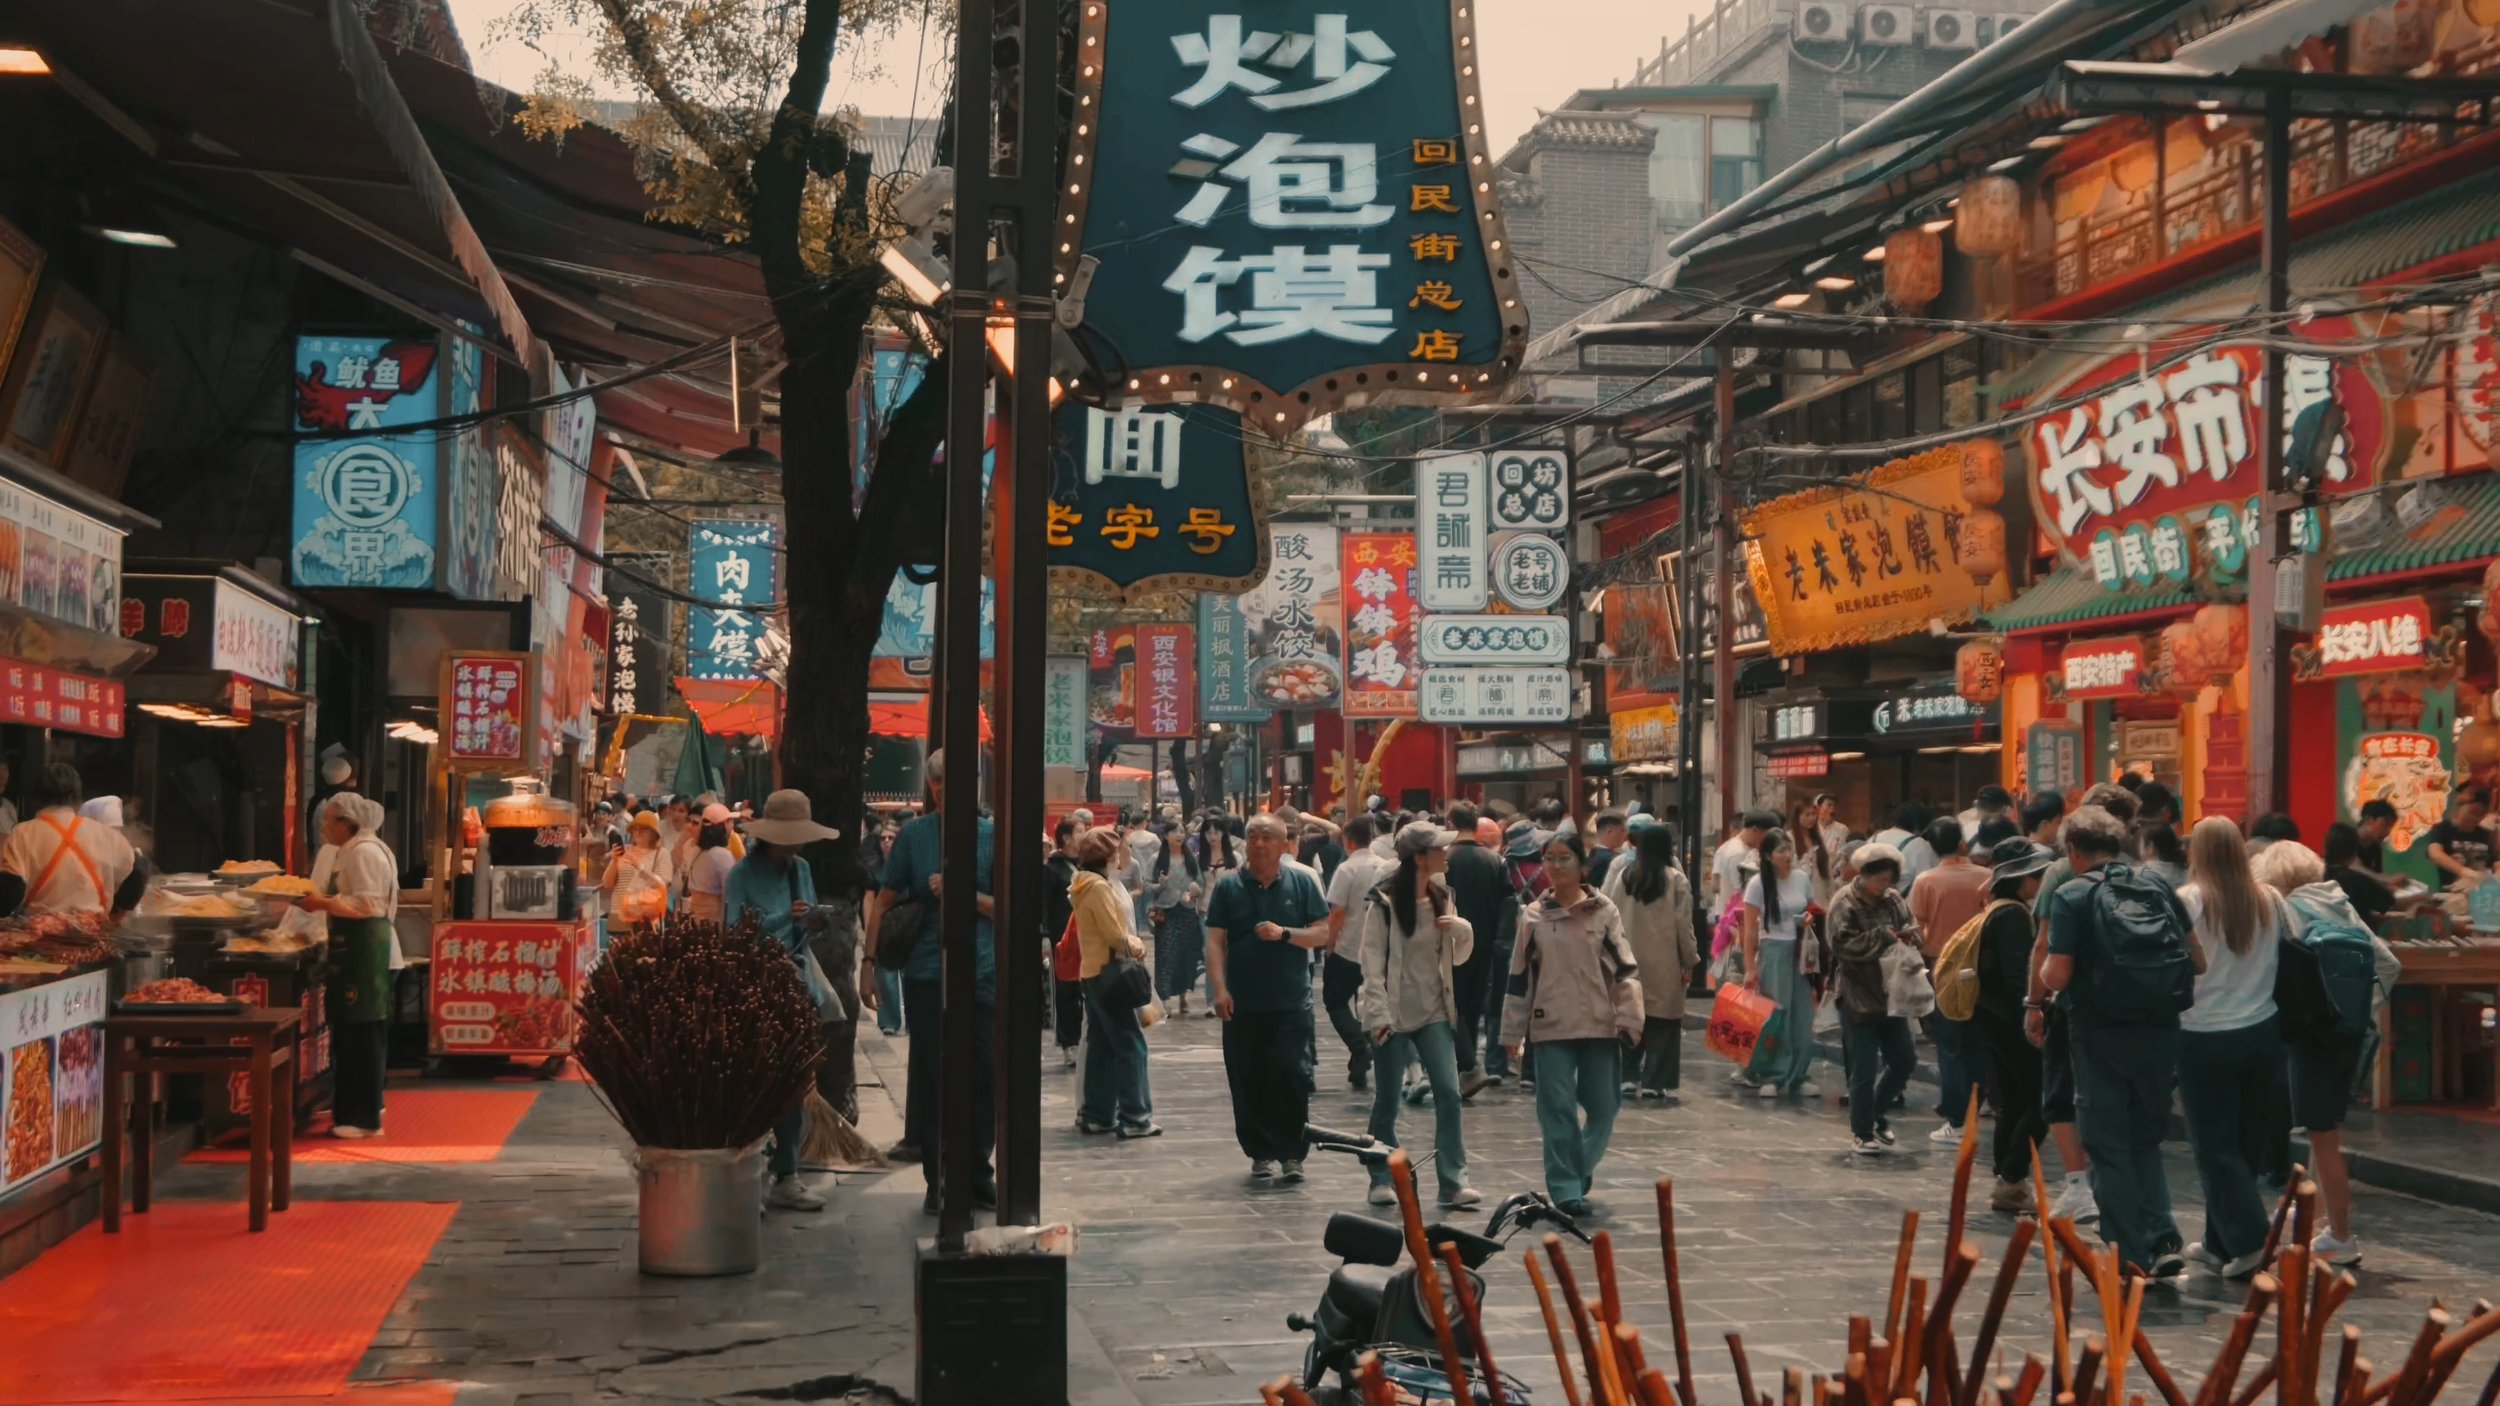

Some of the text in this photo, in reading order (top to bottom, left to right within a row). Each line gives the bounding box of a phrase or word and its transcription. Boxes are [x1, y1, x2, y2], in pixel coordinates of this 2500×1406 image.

[1163, 14, 1397, 346] 炒泡馍
[1409, 138, 1463, 361] 回民街总店
[335, 356, 400, 390] 鱿鱼
[1502, 462, 1556, 487] 回坊
[1047, 503, 1236, 554] 老字号
[1503, 493, 1556, 517] 总店
[1353, 541, 1417, 567] 西安
[1513, 551, 1551, 571] 老号
[2090, 527, 2181, 583] 回民街
[1273, 533, 1315, 659] 酸汤水饺
[1513, 573, 1551, 592] 老铺
[709, 551, 752, 668] 肉夹馍
[1351, 567, 1407, 688] 钵钵鸡
[612, 596, 639, 714] 老孙家泡馍
[1211, 595, 1233, 702] 美丽枫酒店
[1446, 628, 1547, 649] 老米家泡馍
[2320, 613, 2421, 664] 长安八绝
[1151, 635, 1178, 733] 西安银文化馆
[2065, 650, 2136, 689] 西安特产
